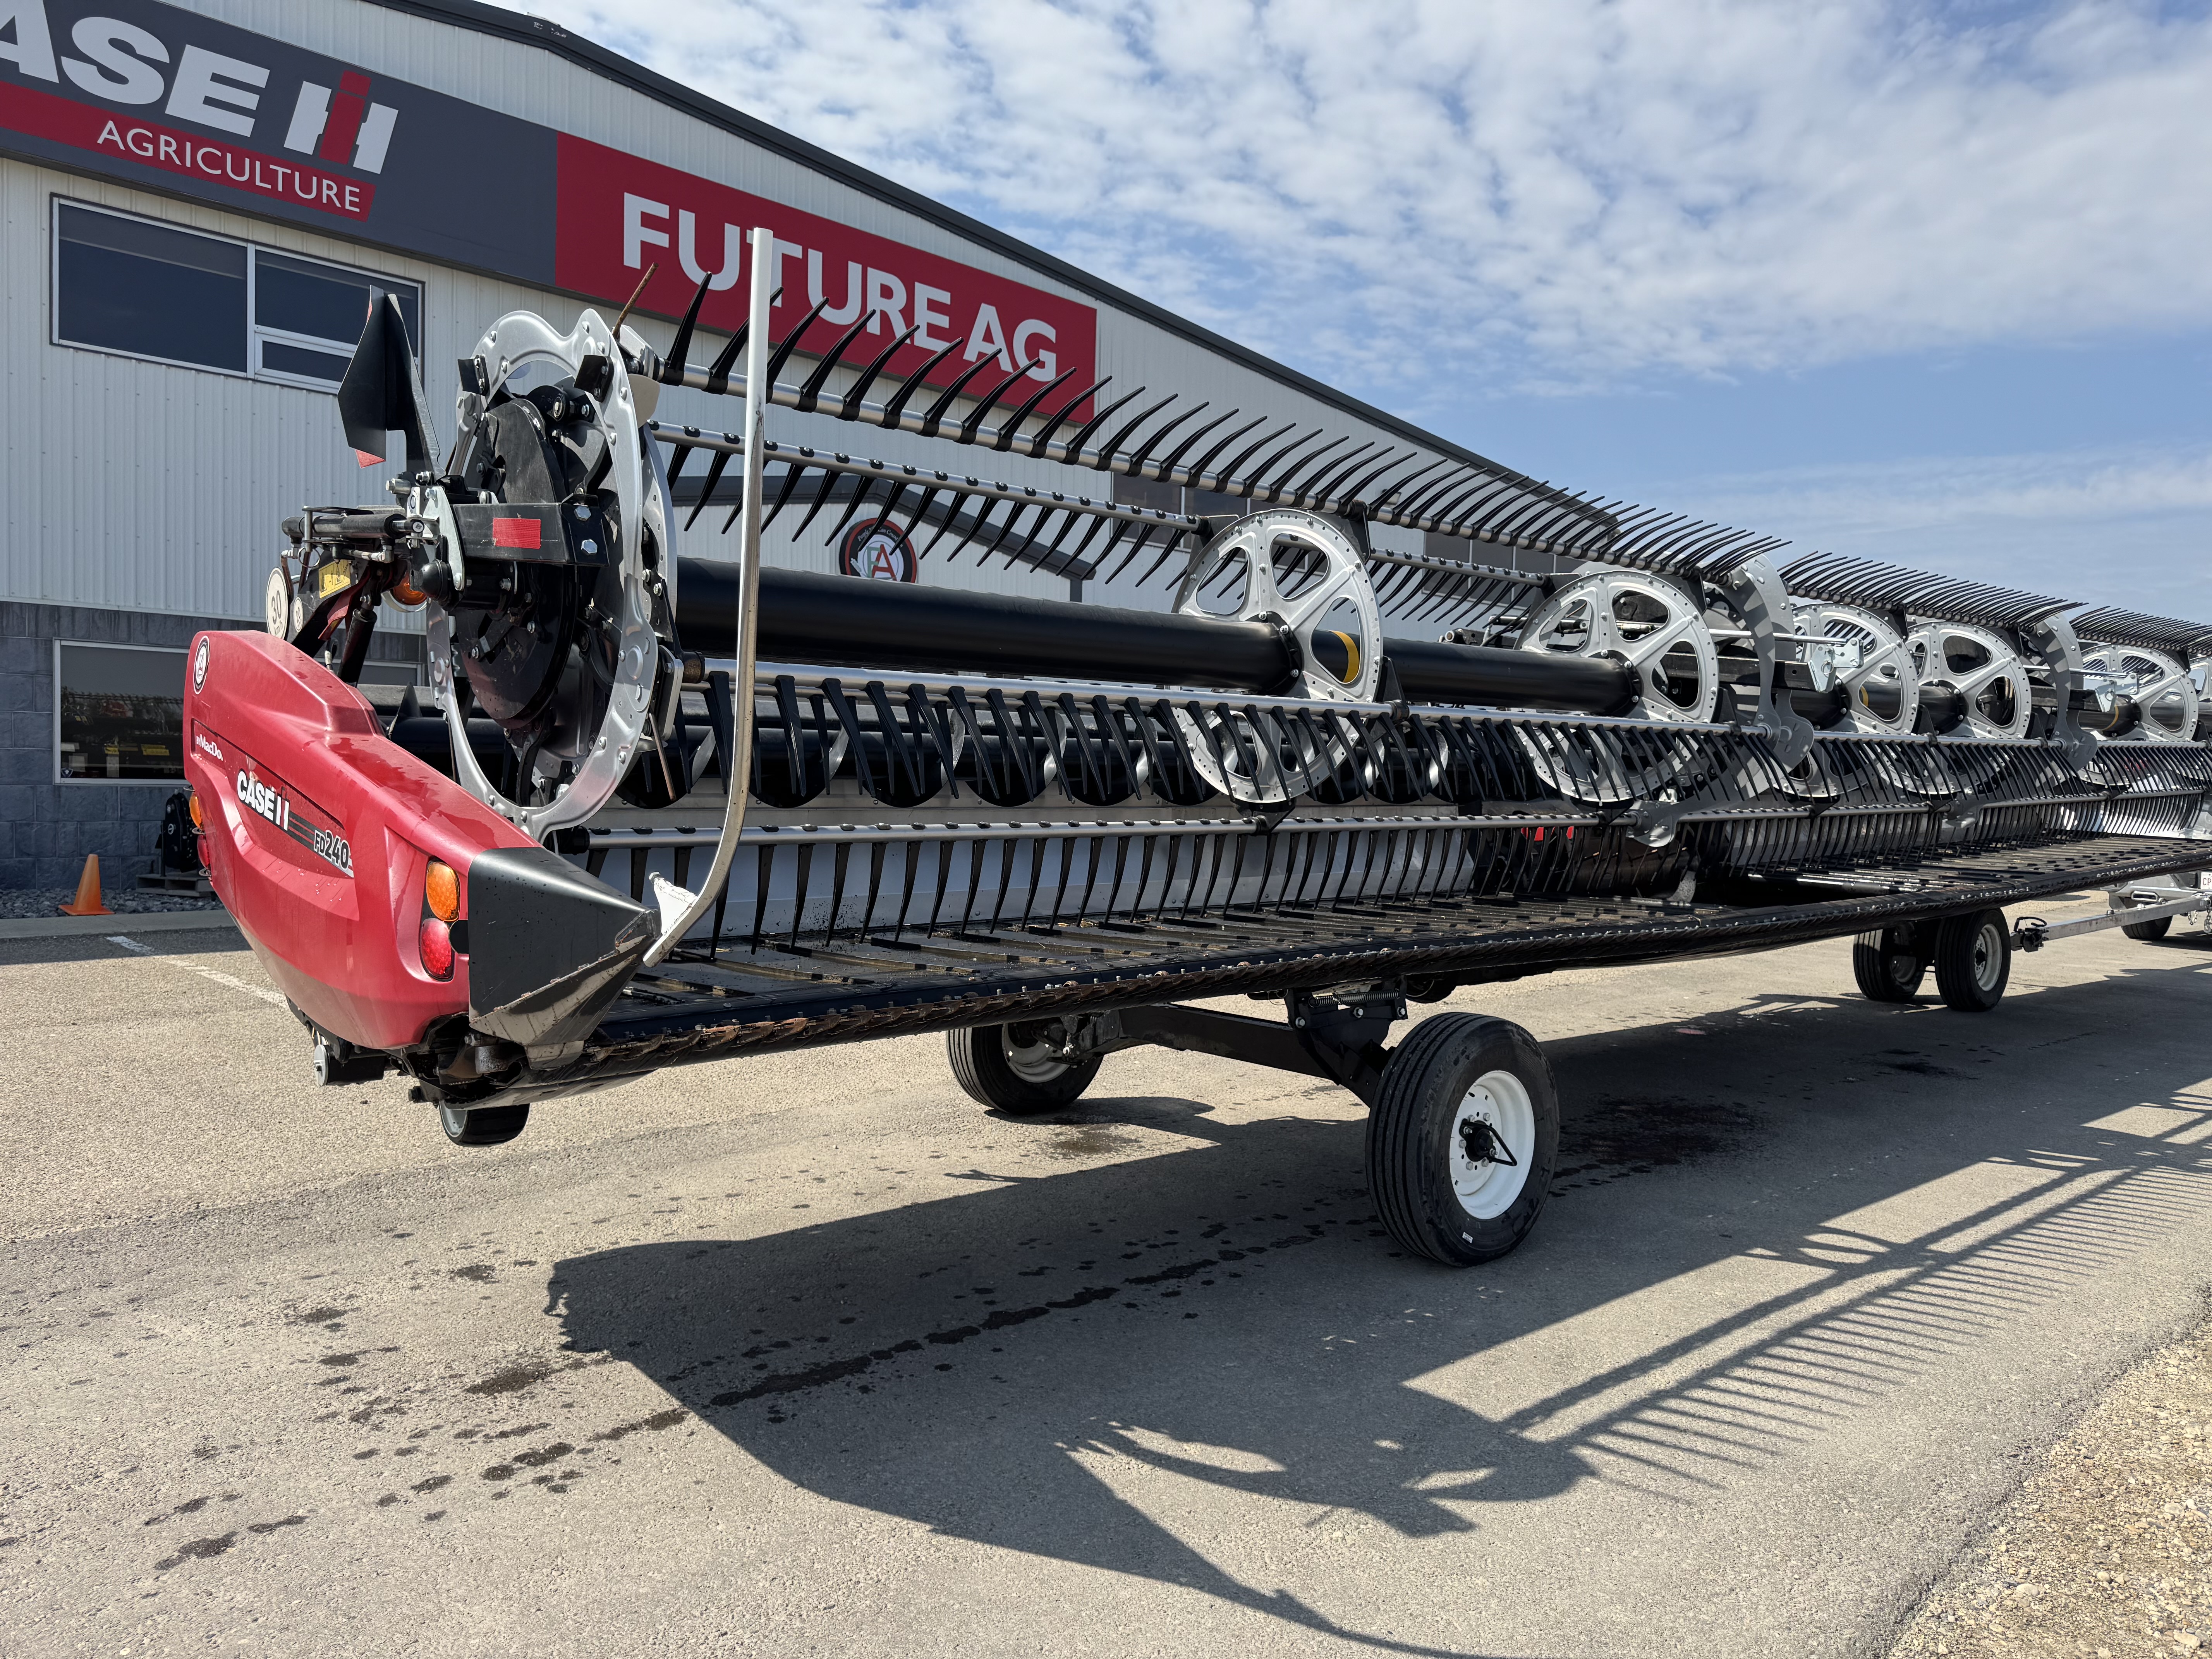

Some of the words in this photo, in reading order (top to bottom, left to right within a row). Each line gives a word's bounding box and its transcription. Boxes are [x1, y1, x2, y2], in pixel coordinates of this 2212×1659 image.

[97, 120, 360, 212] AGRICULTURE
[623, 192, 951, 355] FUTURE
[963, 303, 1056, 382] AG
[271, 590, 282, 625] 30
[274, 620, 283, 636] km/h
[237, 771, 275, 821] CASE
[314, 830, 349, 871] FD240
